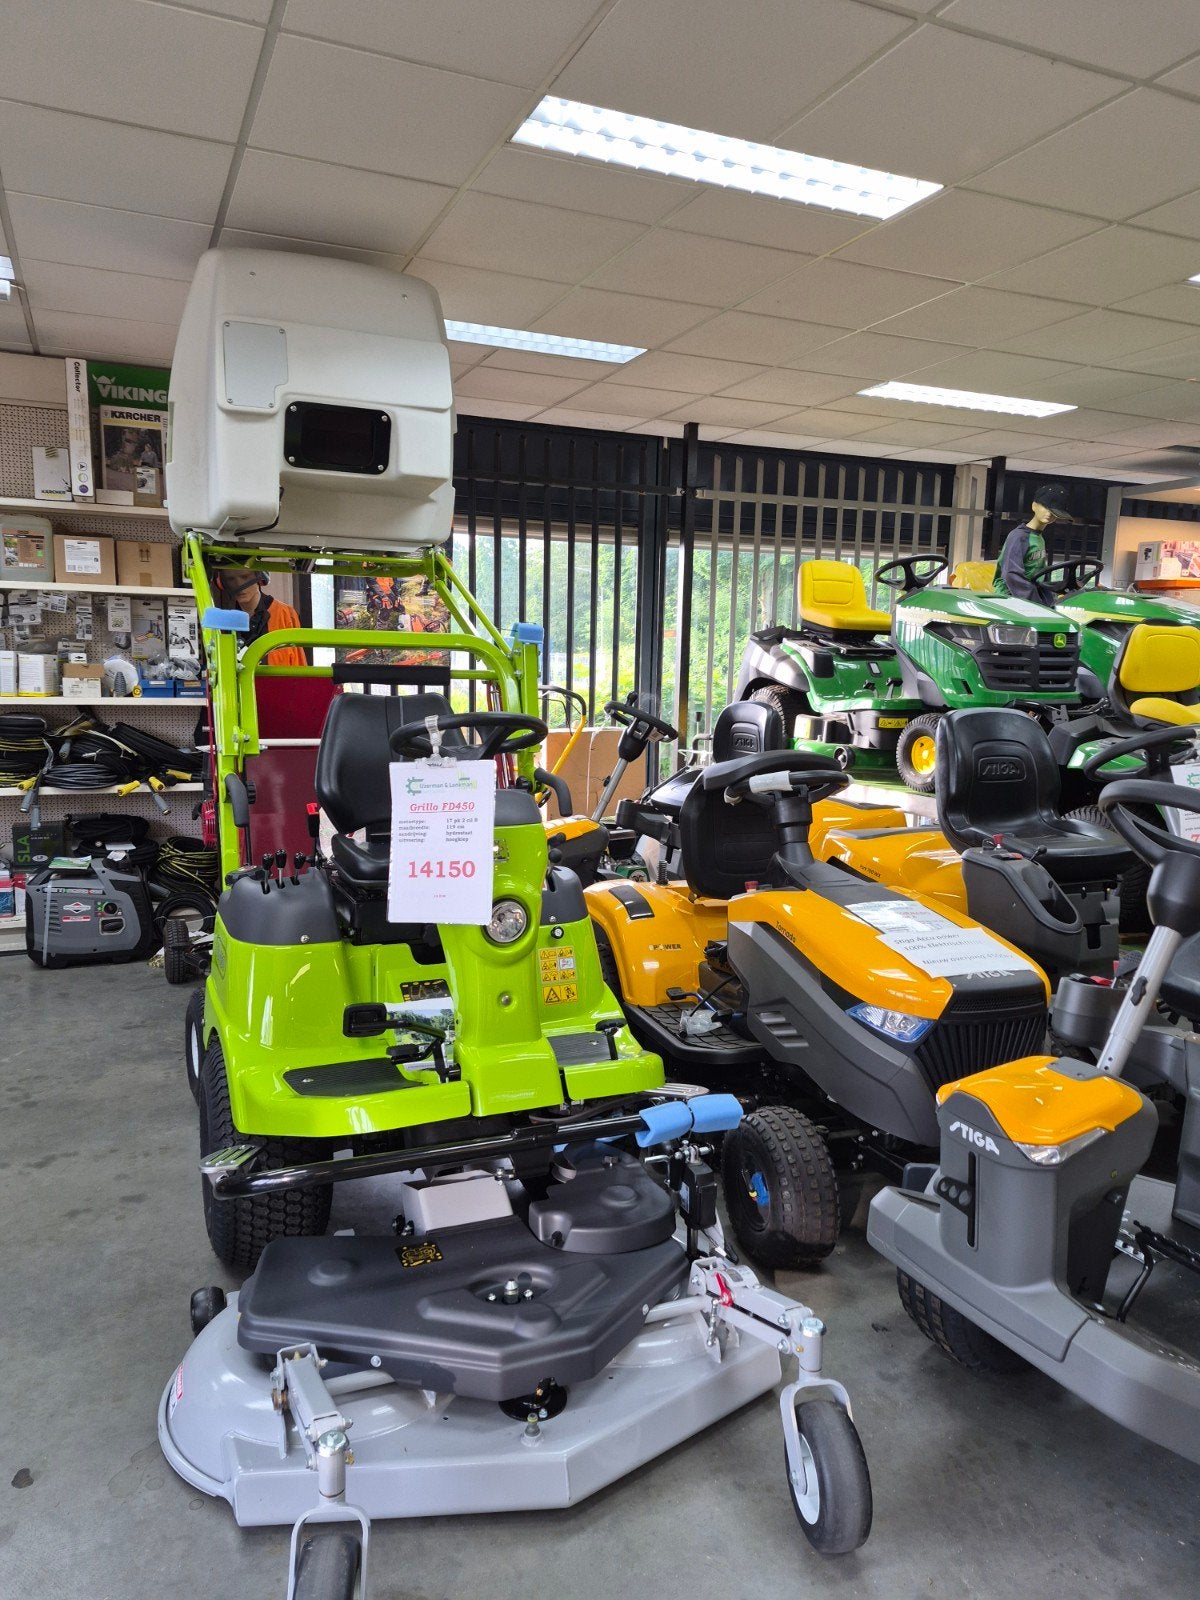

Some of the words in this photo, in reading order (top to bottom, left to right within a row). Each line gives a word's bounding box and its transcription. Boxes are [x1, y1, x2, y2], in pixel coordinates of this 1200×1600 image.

[73, 361, 81, 393] Collector
[97, 383, 167, 404] VIKING
[410, 803, 438, 812] Grillo
[442, 801, 475, 811] FD450
[408, 860, 476, 879] 14150
[949, 1121, 1000, 1156] STIGA
